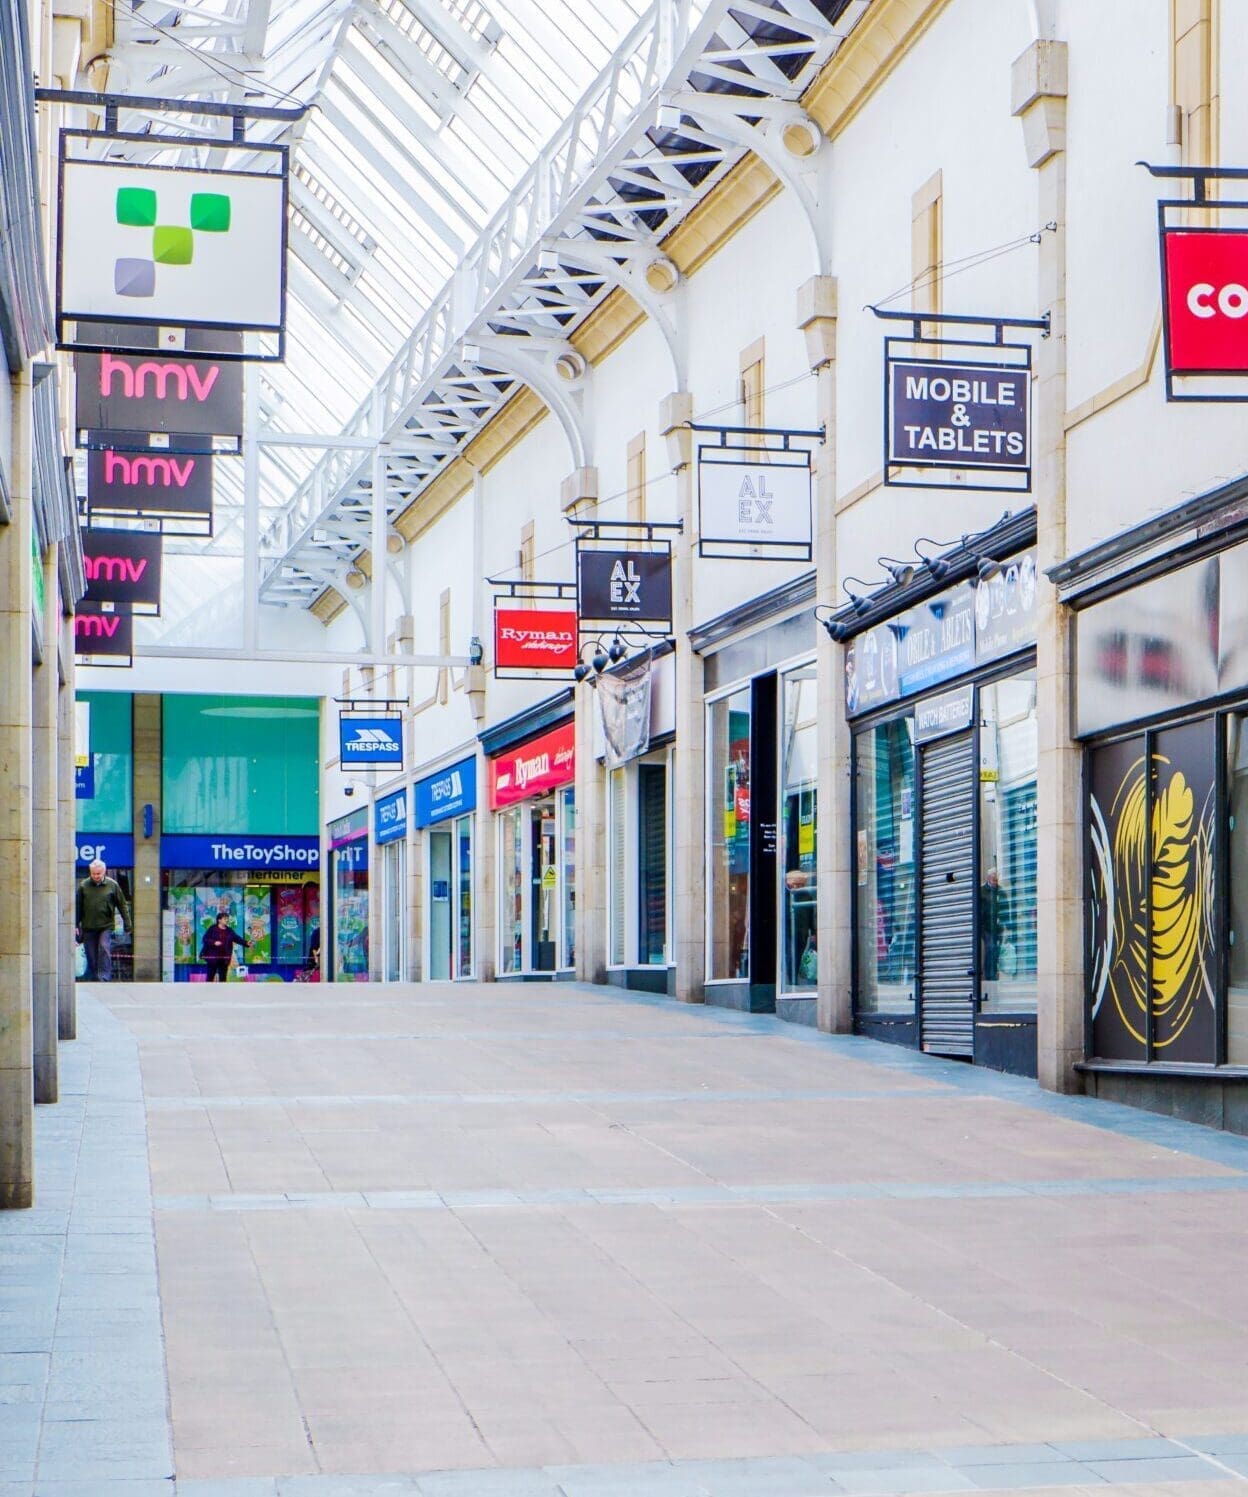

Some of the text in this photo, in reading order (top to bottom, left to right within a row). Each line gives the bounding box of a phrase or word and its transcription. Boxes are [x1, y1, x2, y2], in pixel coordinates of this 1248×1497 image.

[100, 352, 219, 401] hmv
[906, 376, 1015, 406] MOBILE
[950, 403, 971, 427] &
[904, 425, 1024, 456] TABLETS
[104, 449, 195, 488] hmv
[738, 474, 774, 498] AL
[738, 499, 774, 524] EX
[610, 559, 641, 581] AL
[610, 581, 641, 603] EX
[501, 627, 573, 643] Ryman
[345, 742, 399, 752] TRESPASS
[514, 752, 550, 790] Ryman
[75, 843, 320, 865] er TheToyShop
